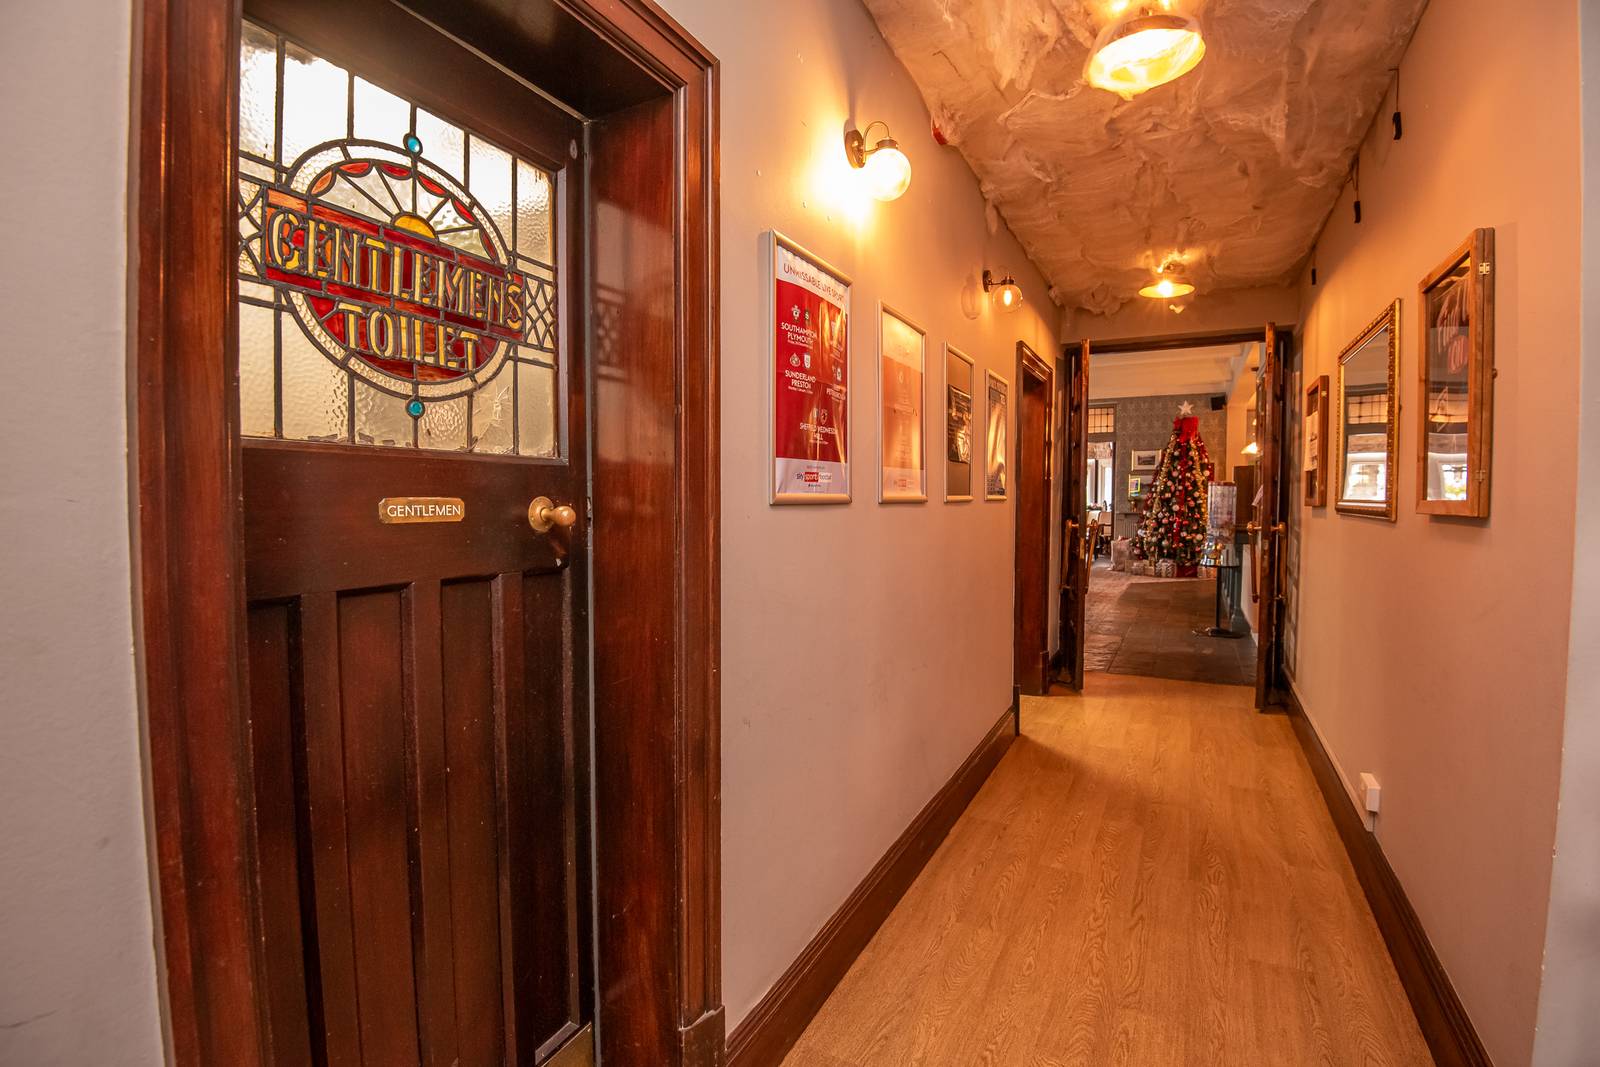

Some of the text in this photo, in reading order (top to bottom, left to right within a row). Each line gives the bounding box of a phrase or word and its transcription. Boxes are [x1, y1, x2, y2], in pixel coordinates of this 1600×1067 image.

[335, 301, 481, 373] TOILET
[784, 369, 817, 383] SUNDERLAND
[791, 378, 812, 389] PRESTON
[386, 504, 462, 517] GENTLEMEN
